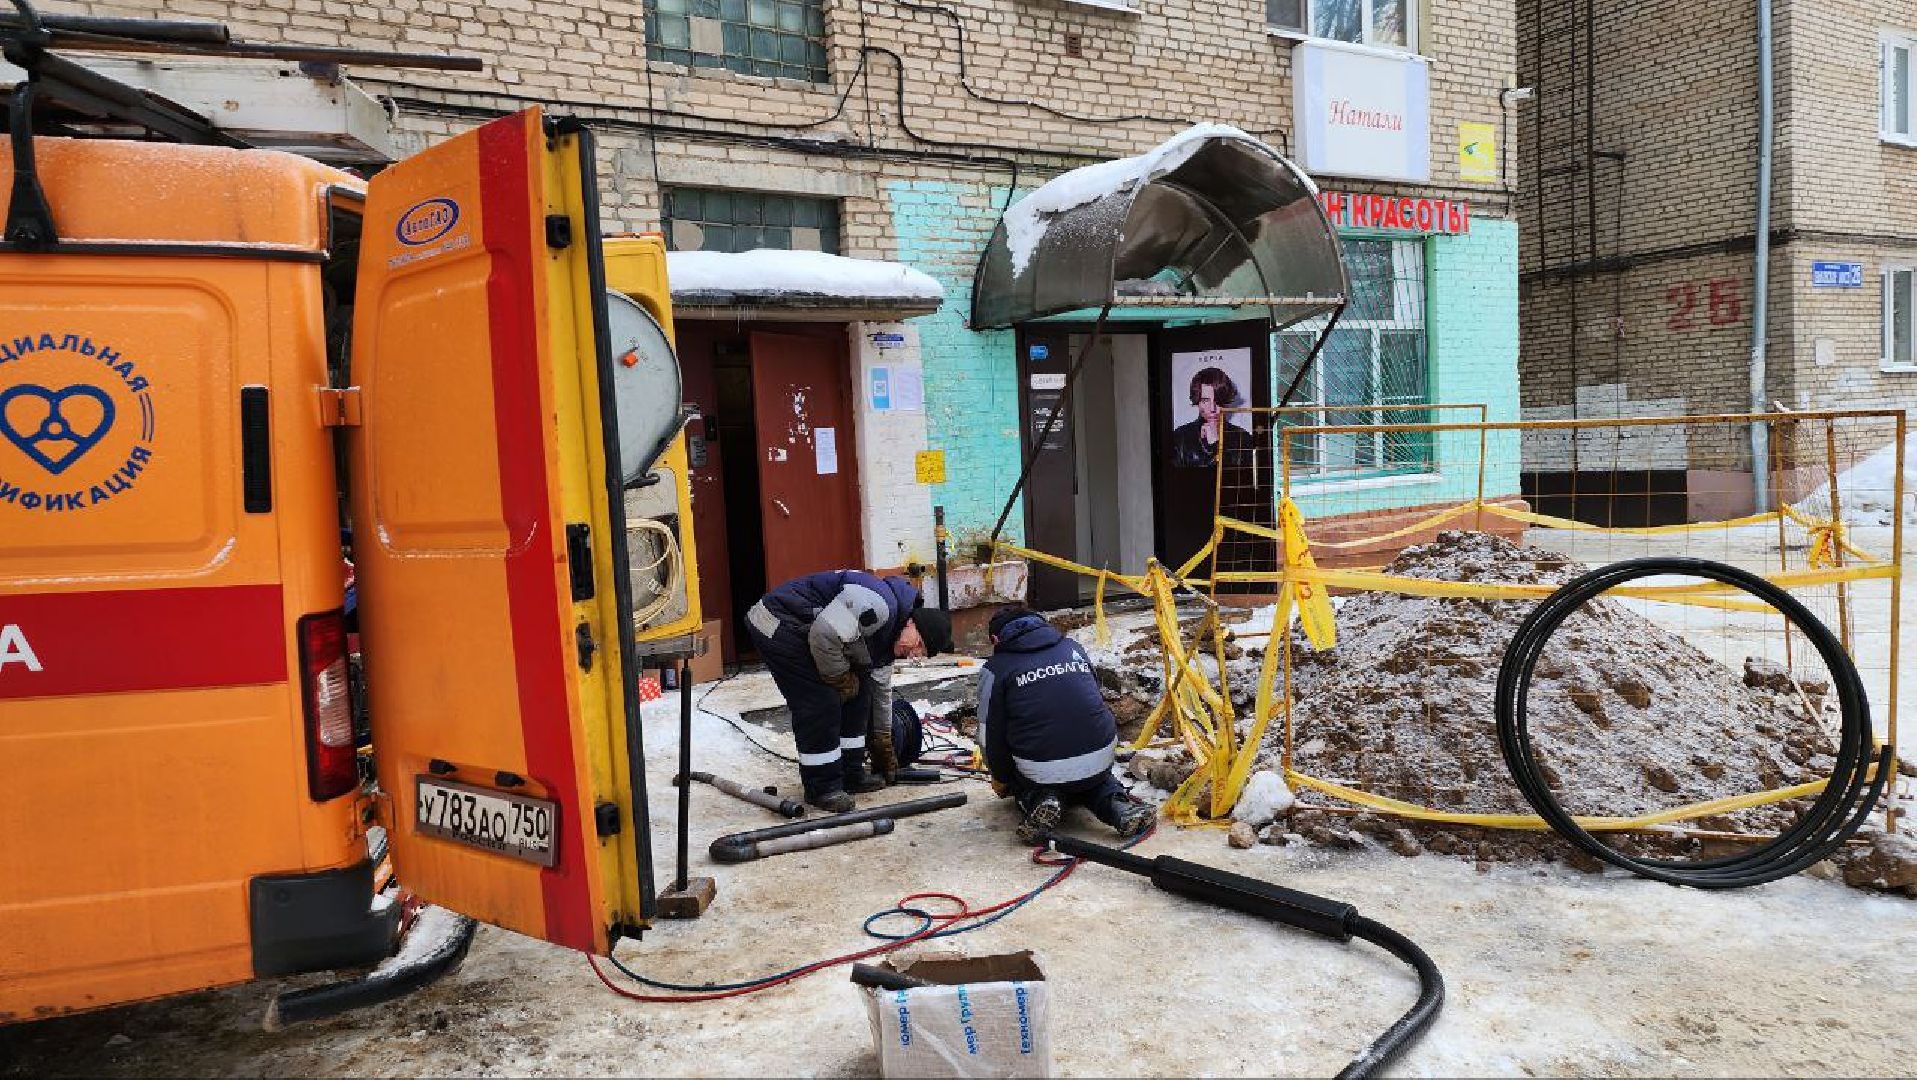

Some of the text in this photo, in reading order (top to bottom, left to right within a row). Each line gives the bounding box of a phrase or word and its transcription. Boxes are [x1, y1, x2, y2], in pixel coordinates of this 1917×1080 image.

[1329, 100, 1402, 131] Натали
[1351, 192, 1470, 234] КРАСОТЫ
[0, 624, 44, 672] А
[511, 803, 548, 840] 750
